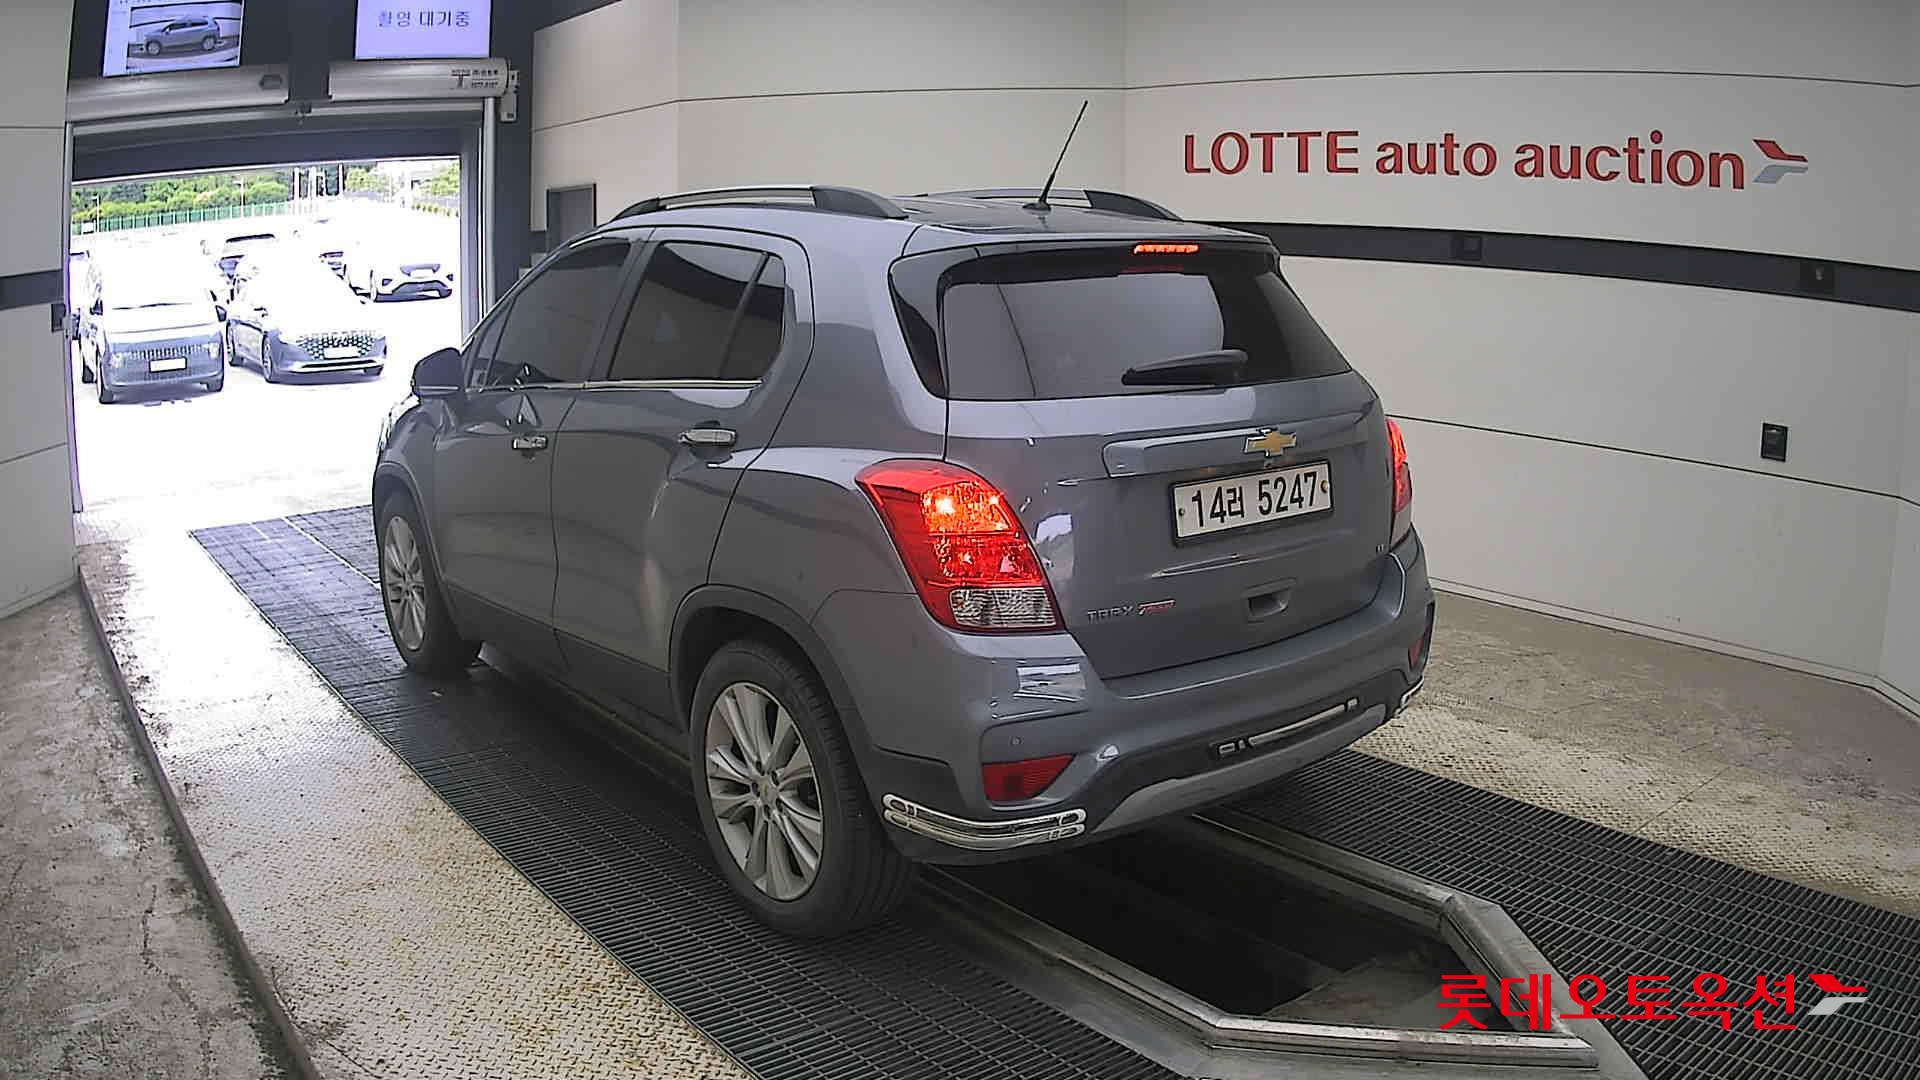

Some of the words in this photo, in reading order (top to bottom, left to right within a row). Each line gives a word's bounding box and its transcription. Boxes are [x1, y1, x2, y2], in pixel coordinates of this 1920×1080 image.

[419, 11, 470, 27] 대기중
[1184, 131, 1360, 175] LOTTE
[1376, 132, 1498, 176] auto
[1513, 130, 1746, 190] auction
[1191, 486, 1245, 527] 14러
[1258, 471, 1318, 516] 5247
